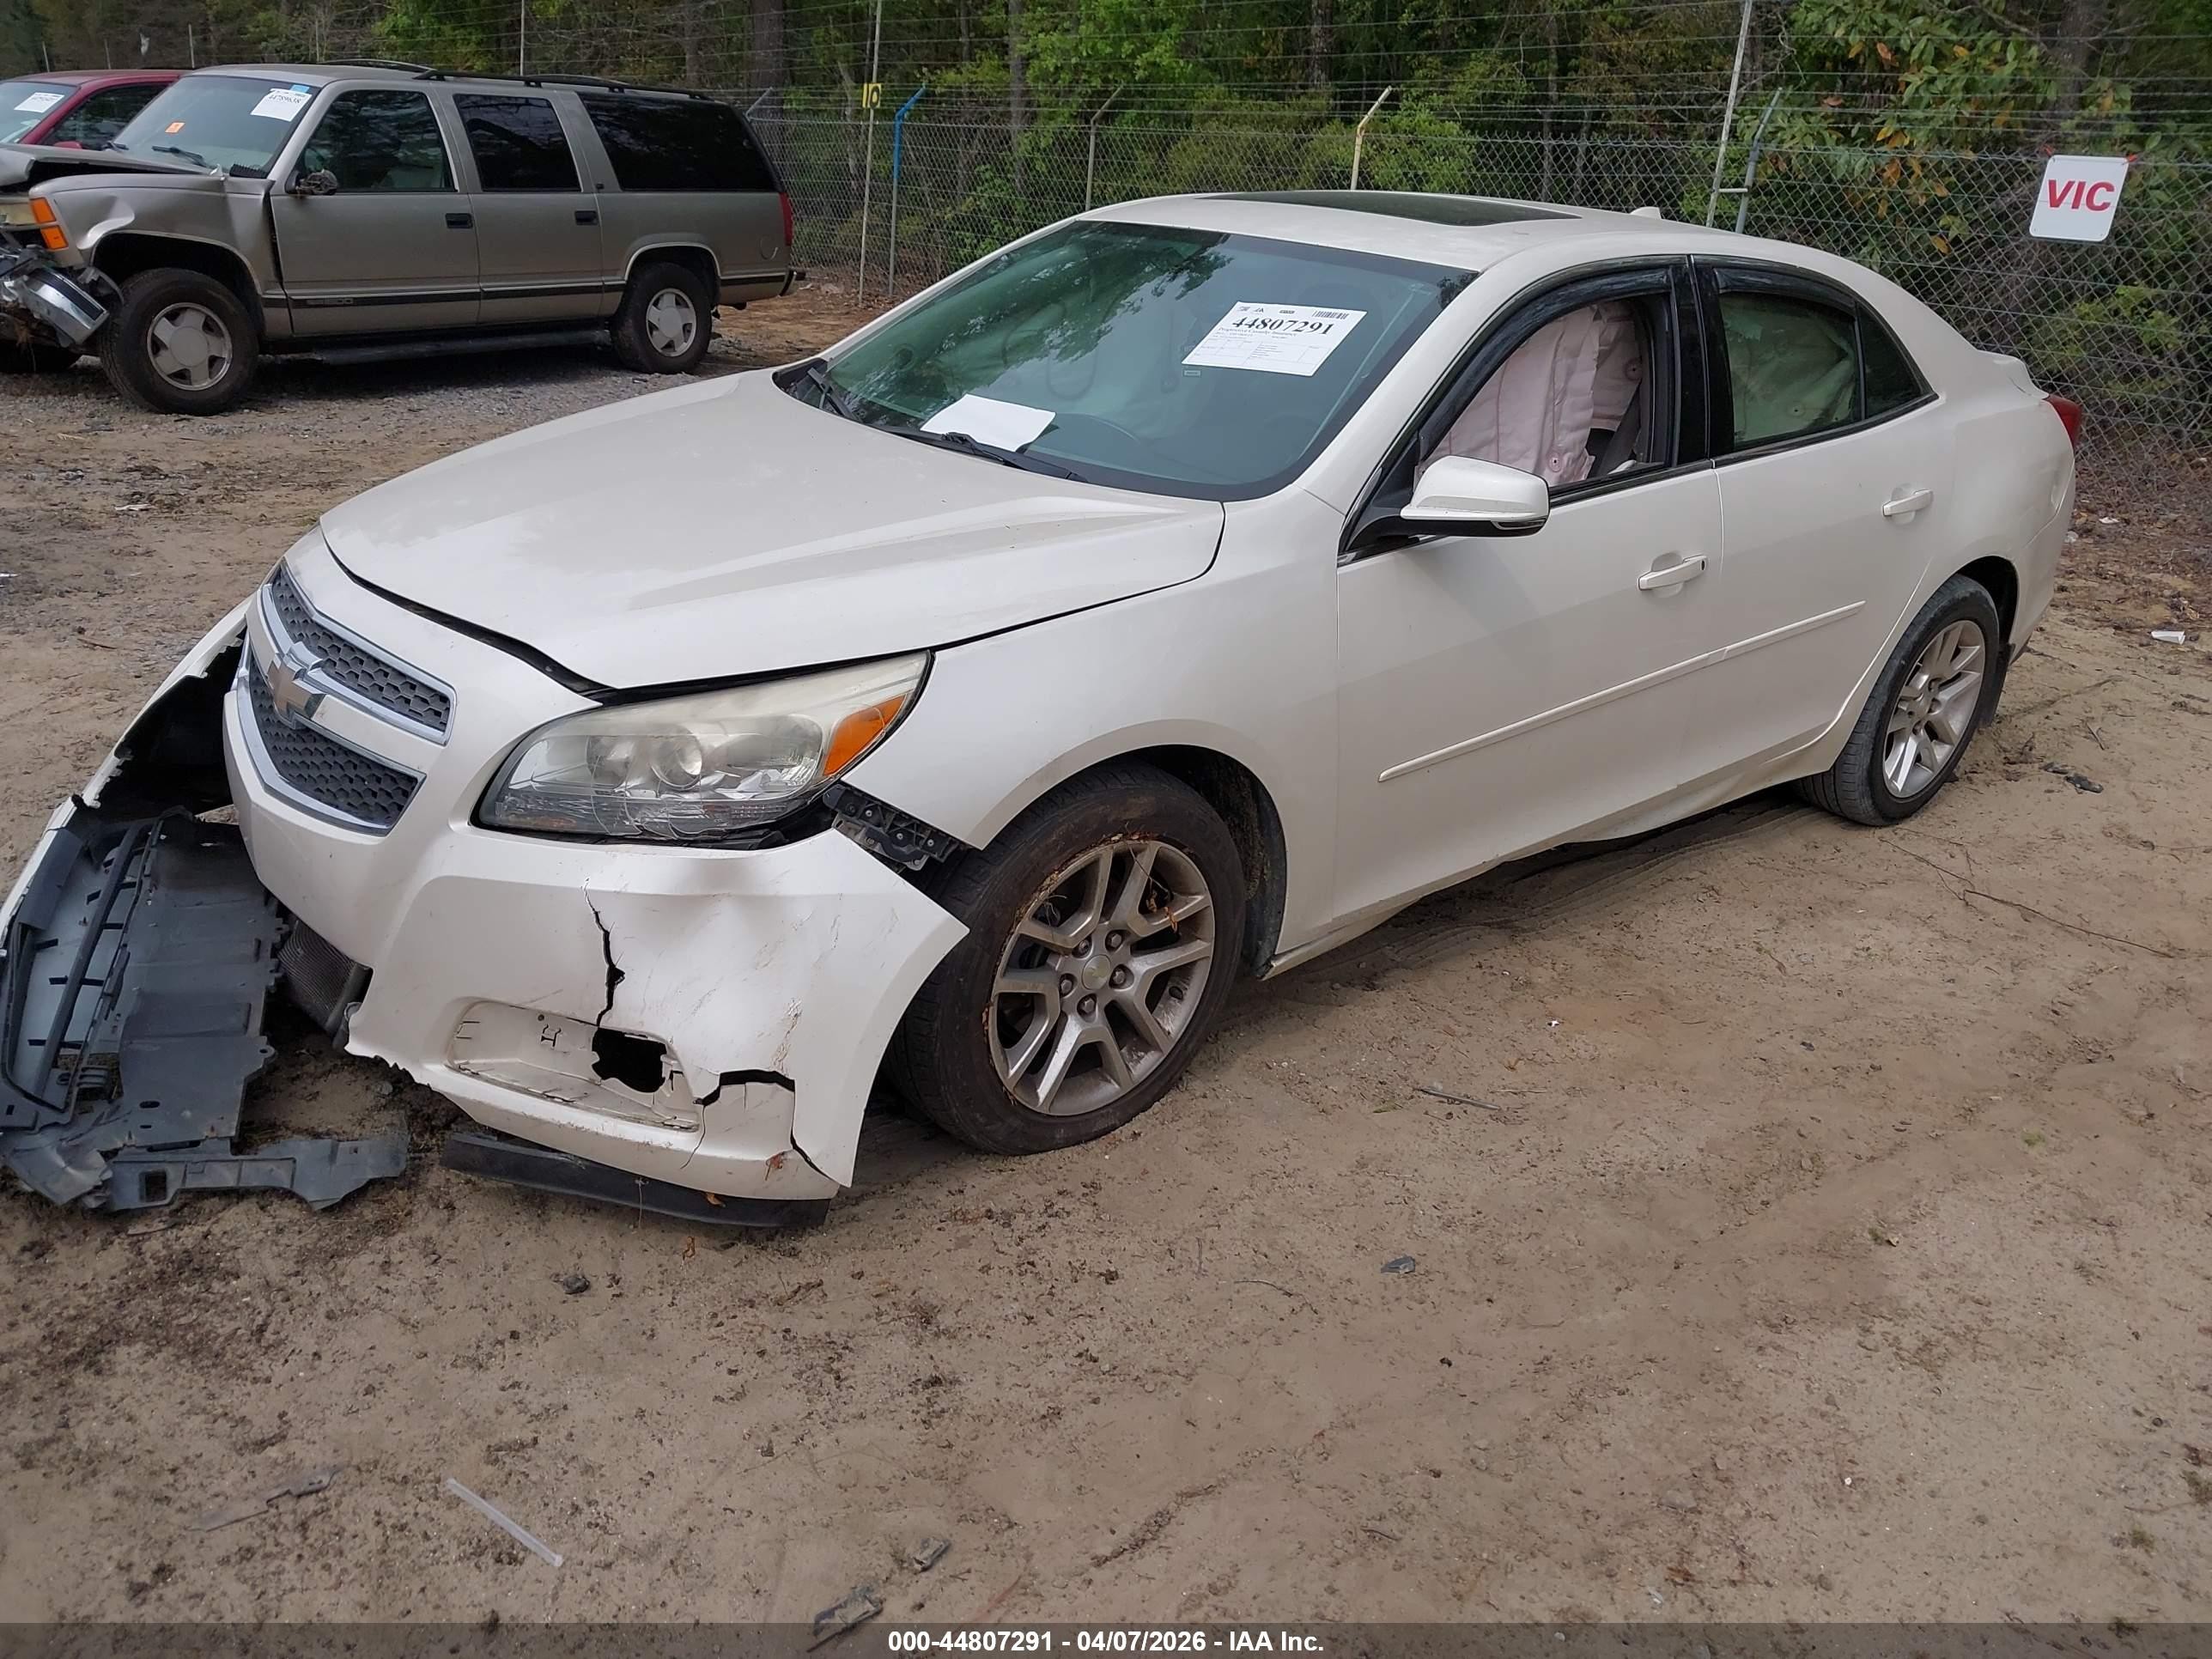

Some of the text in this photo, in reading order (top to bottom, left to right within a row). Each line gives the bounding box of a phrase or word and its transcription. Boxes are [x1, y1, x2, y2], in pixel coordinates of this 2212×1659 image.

[866, 82, 880, 108] 10
[2048, 179, 2115, 212] VIC
[1231, 316, 1334, 335] 44807291
